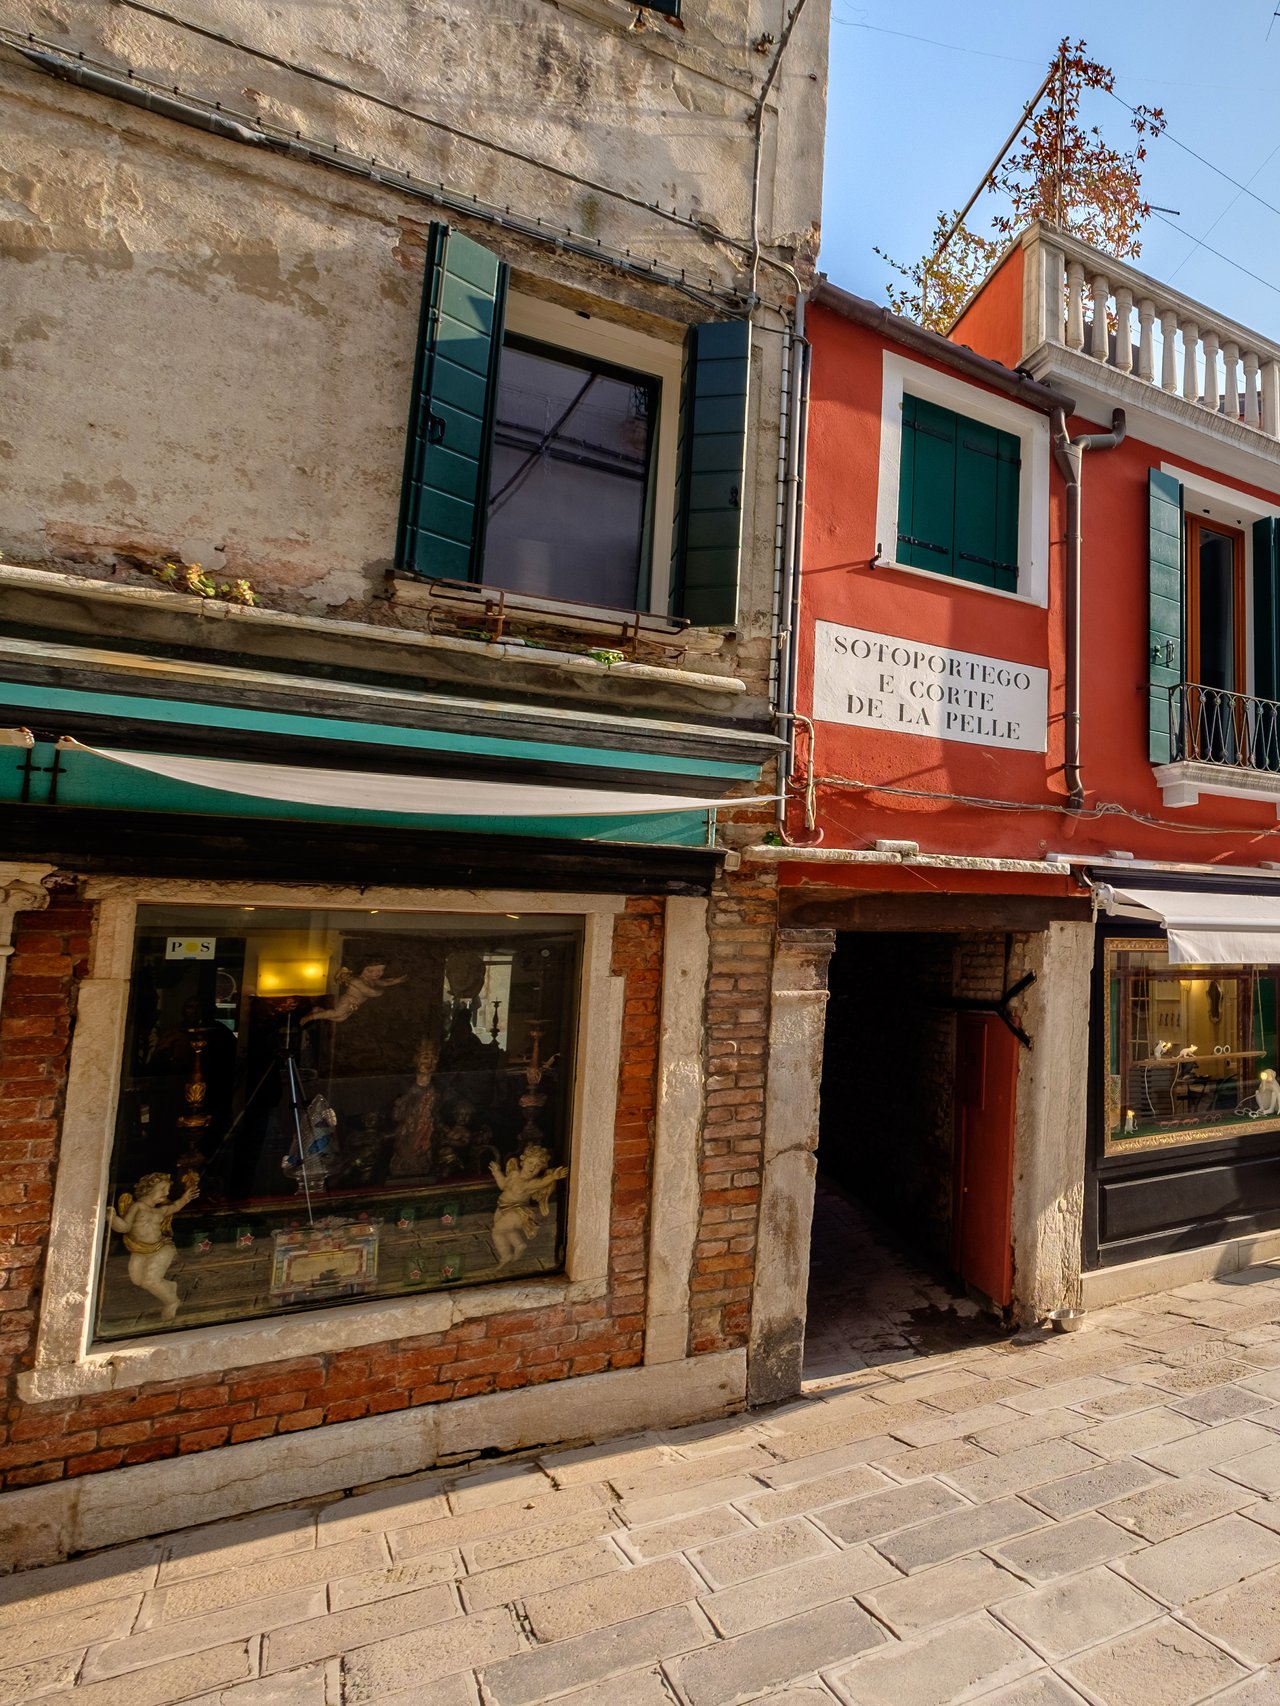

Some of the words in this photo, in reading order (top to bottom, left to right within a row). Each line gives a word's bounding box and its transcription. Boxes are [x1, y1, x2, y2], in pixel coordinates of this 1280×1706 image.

[834, 635, 1031, 691] SOTOPORTEGO
[879, 673, 895, 694] E
[909, 679, 995, 712] CORTE
[847, 693, 883, 719] DE
[898, 702, 931, 726] LA
[946, 711, 1020, 741] PELLE
